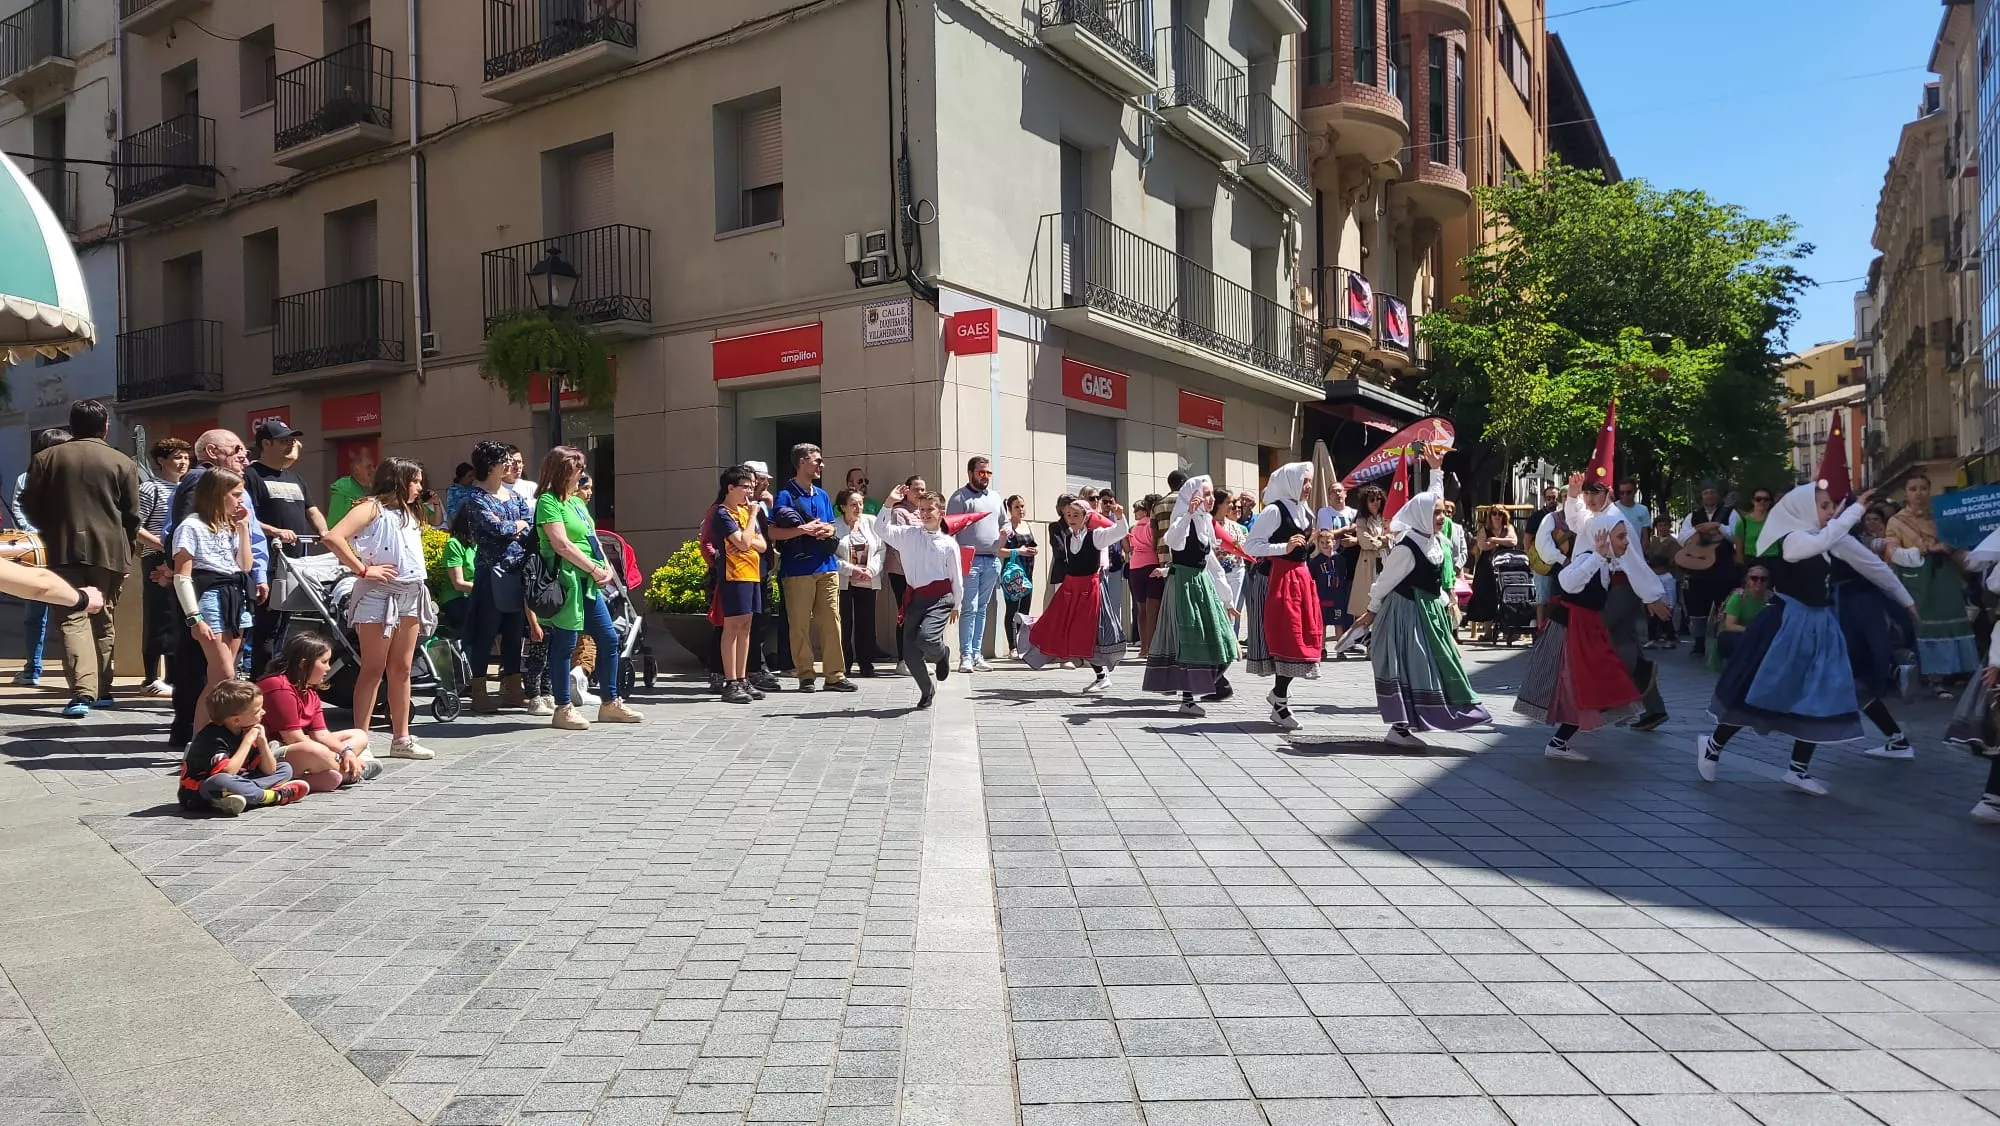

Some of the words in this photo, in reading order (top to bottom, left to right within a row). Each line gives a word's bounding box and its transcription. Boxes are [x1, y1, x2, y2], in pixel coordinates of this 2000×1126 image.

[882, 306, 906, 318] CALLE
[957, 322, 990, 337] GAES
[781, 350, 817, 363] amplifon
[1081, 372, 1113, 400] GAES
[1961, 493, 1996, 505] ESCUELA
